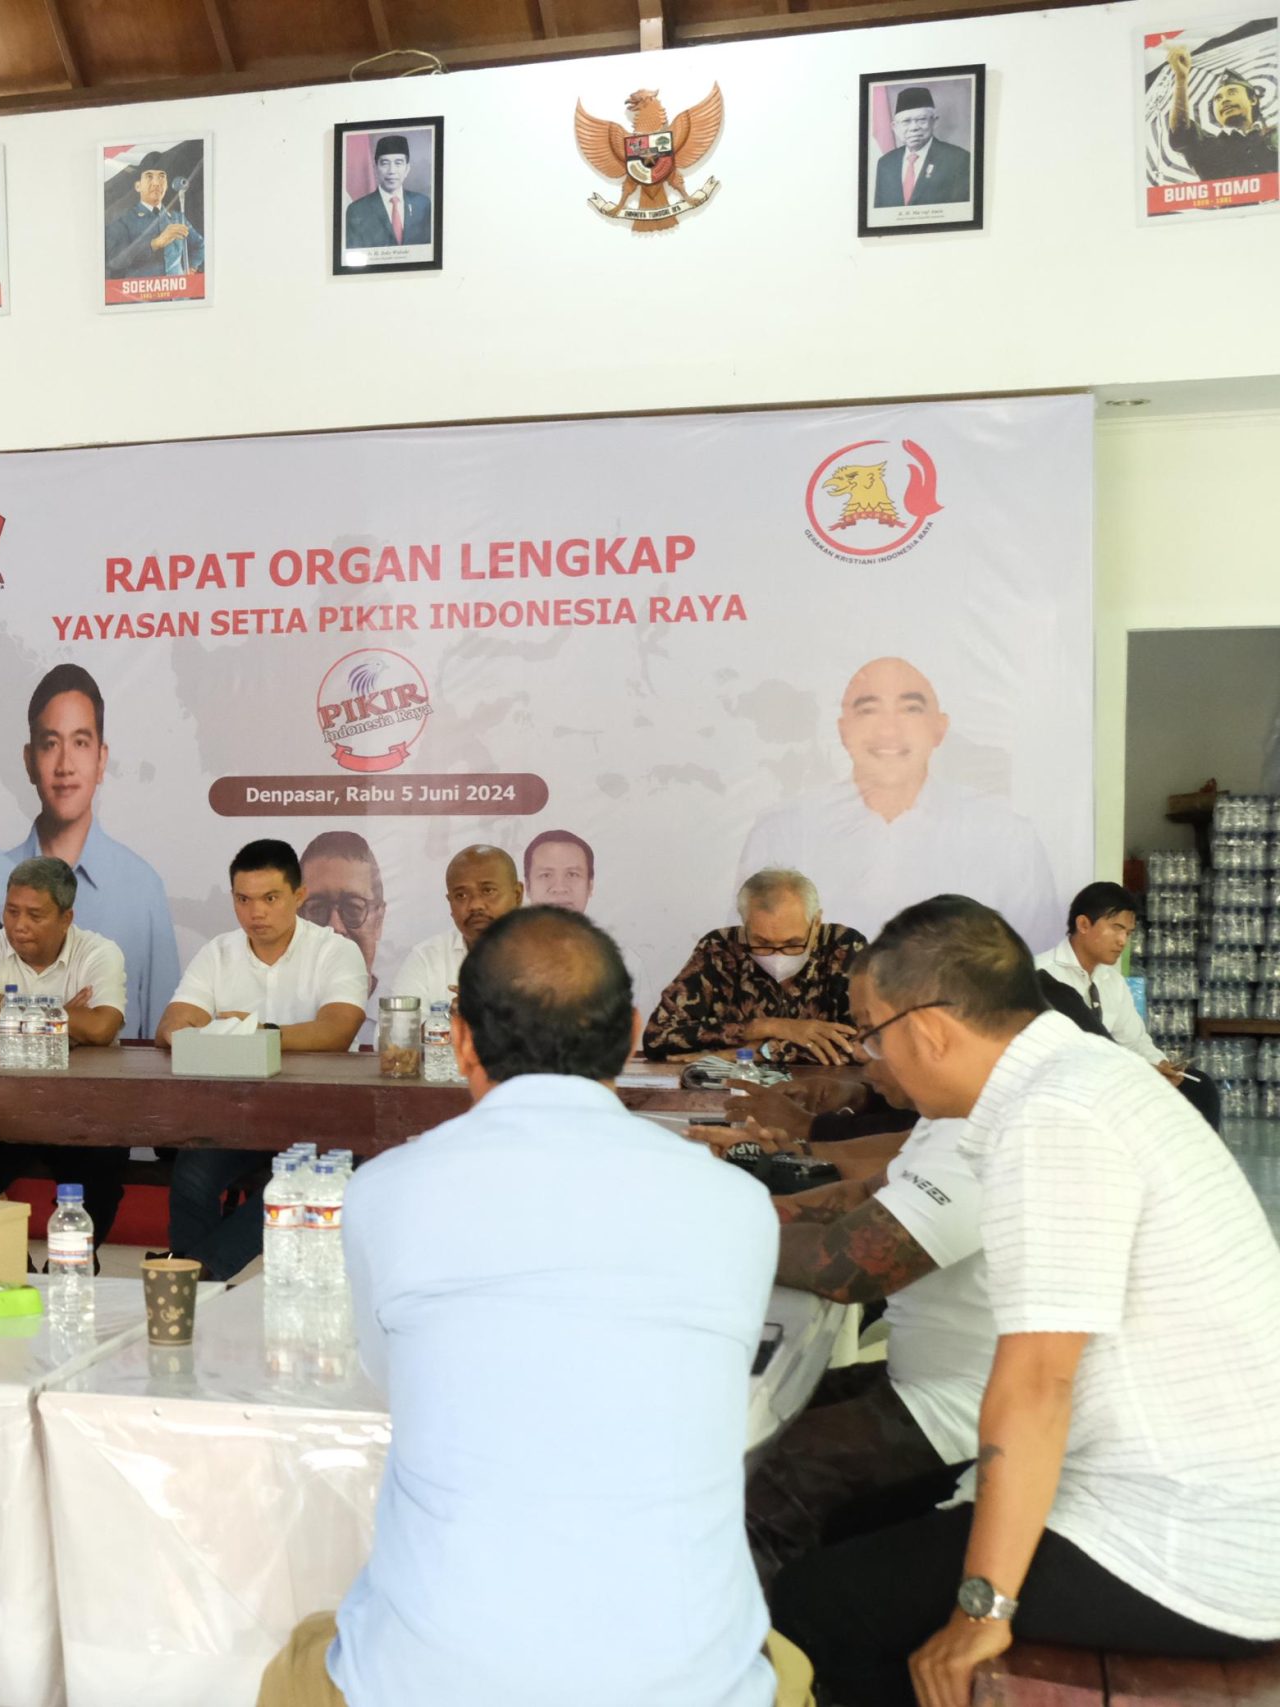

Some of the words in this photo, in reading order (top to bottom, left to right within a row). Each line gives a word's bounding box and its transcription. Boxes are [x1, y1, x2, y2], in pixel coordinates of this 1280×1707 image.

[1164, 184, 1209, 203] BUNG
[1213, 178, 1261, 197] TOMO
[122, 277, 187, 295] SOEKARNO
[804, 529, 834, 557] GERAKAN
[835, 553, 876, 565] KRISTIANI
[878, 539, 919, 564] INDONESIA
[918, 521, 934, 541] RAYA
[105, 551, 256, 593] RAPAT
[268, 544, 441, 585] ORGAN
[460, 535, 696, 580] LENGKAP
[52, 611, 201, 641] YAYASAN
[210, 607, 308, 637] SETIA
[319, 603, 419, 633] PIKIR
[430, 597, 637, 630] INDONESIA
[649, 594, 748, 623] RAYA
[317, 683, 429, 730] PIKIR
[322, 715, 396, 743] Indonesia
[396, 704, 434, 723] Raya
[245, 787, 339, 806] Denpasar,
[346, 786, 395, 802] Rabu
[401, 786, 413, 801] 5
[418, 785, 460, 801] Juni
[465, 784, 516, 801] 2024
